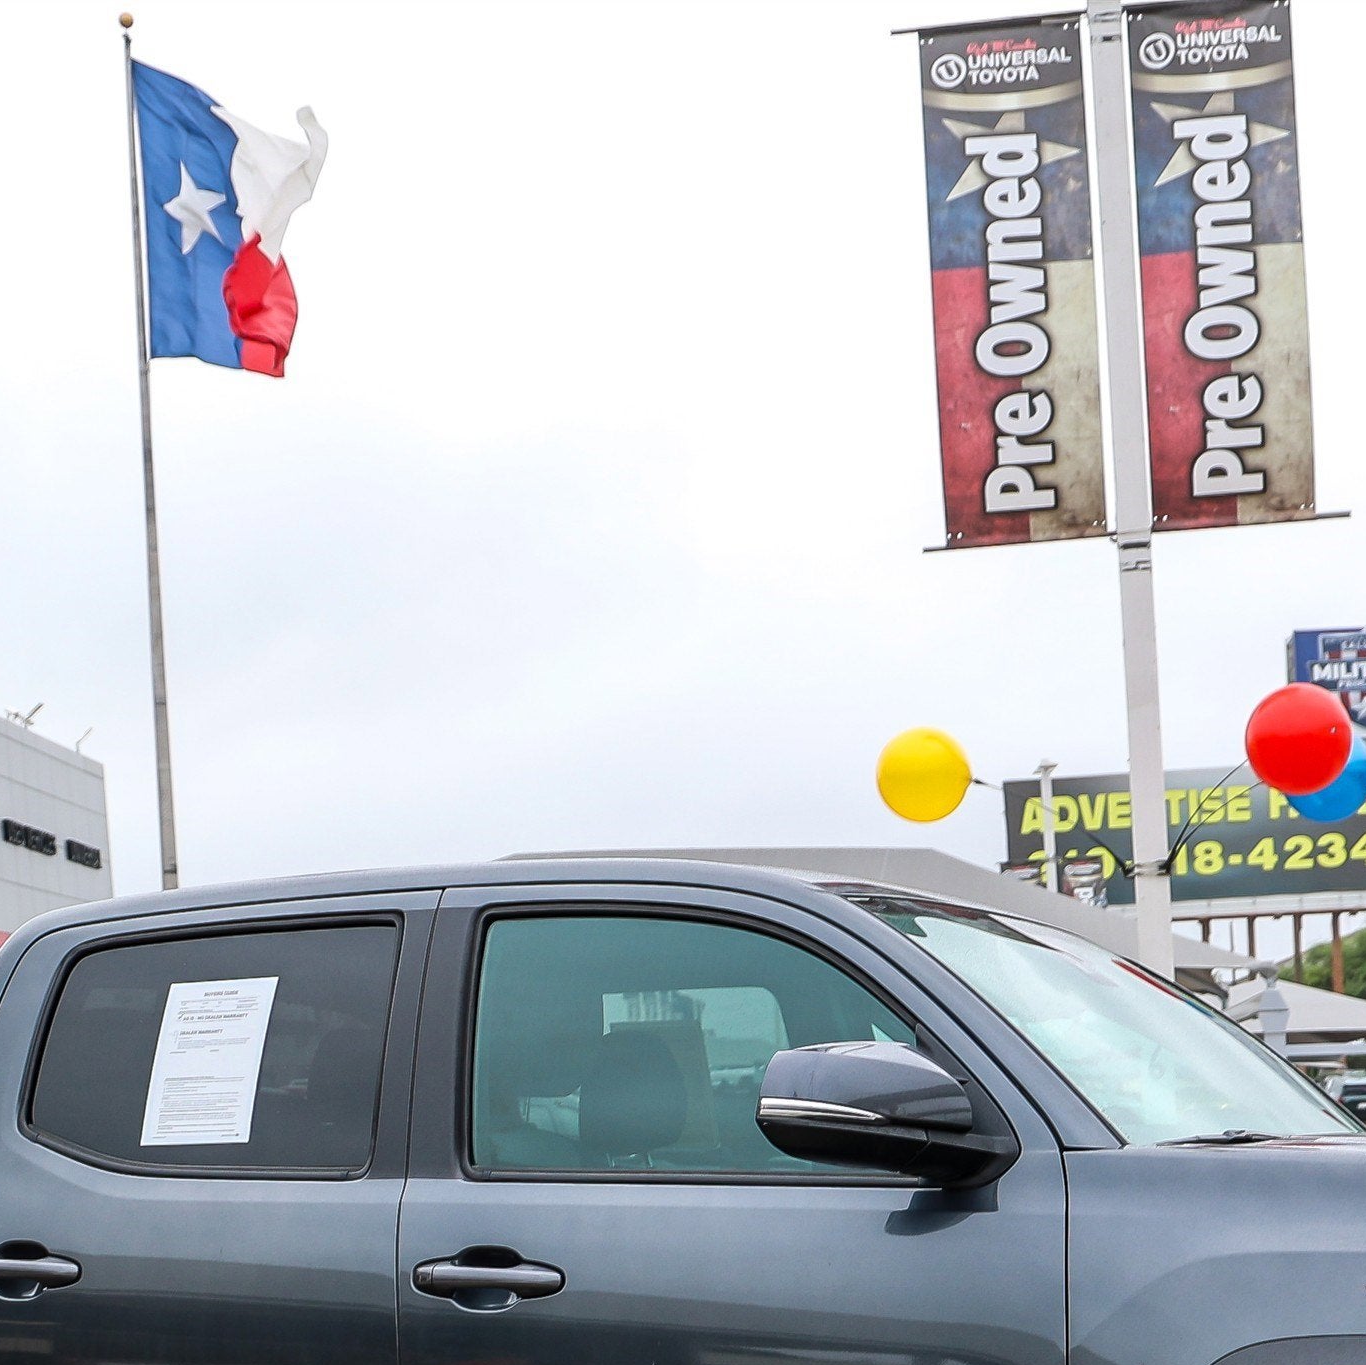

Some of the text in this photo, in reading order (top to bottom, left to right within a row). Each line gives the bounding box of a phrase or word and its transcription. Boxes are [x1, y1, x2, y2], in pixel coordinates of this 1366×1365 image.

[968, 46, 1073, 69] UNIVERSAL
[1176, 43, 1250, 65] TOYOTA
[1177, 24, 1283, 48] UNIVERSAL
[968, 65, 1040, 85] TOYOTA
[963, 133, 1051, 378] Owned
[1173, 114, 1261, 361] Owned
[983, 390, 1057, 514] Pre
[1192, 374, 1266, 498] Pre
[1020, 785, 1253, 835] ADVETISE
